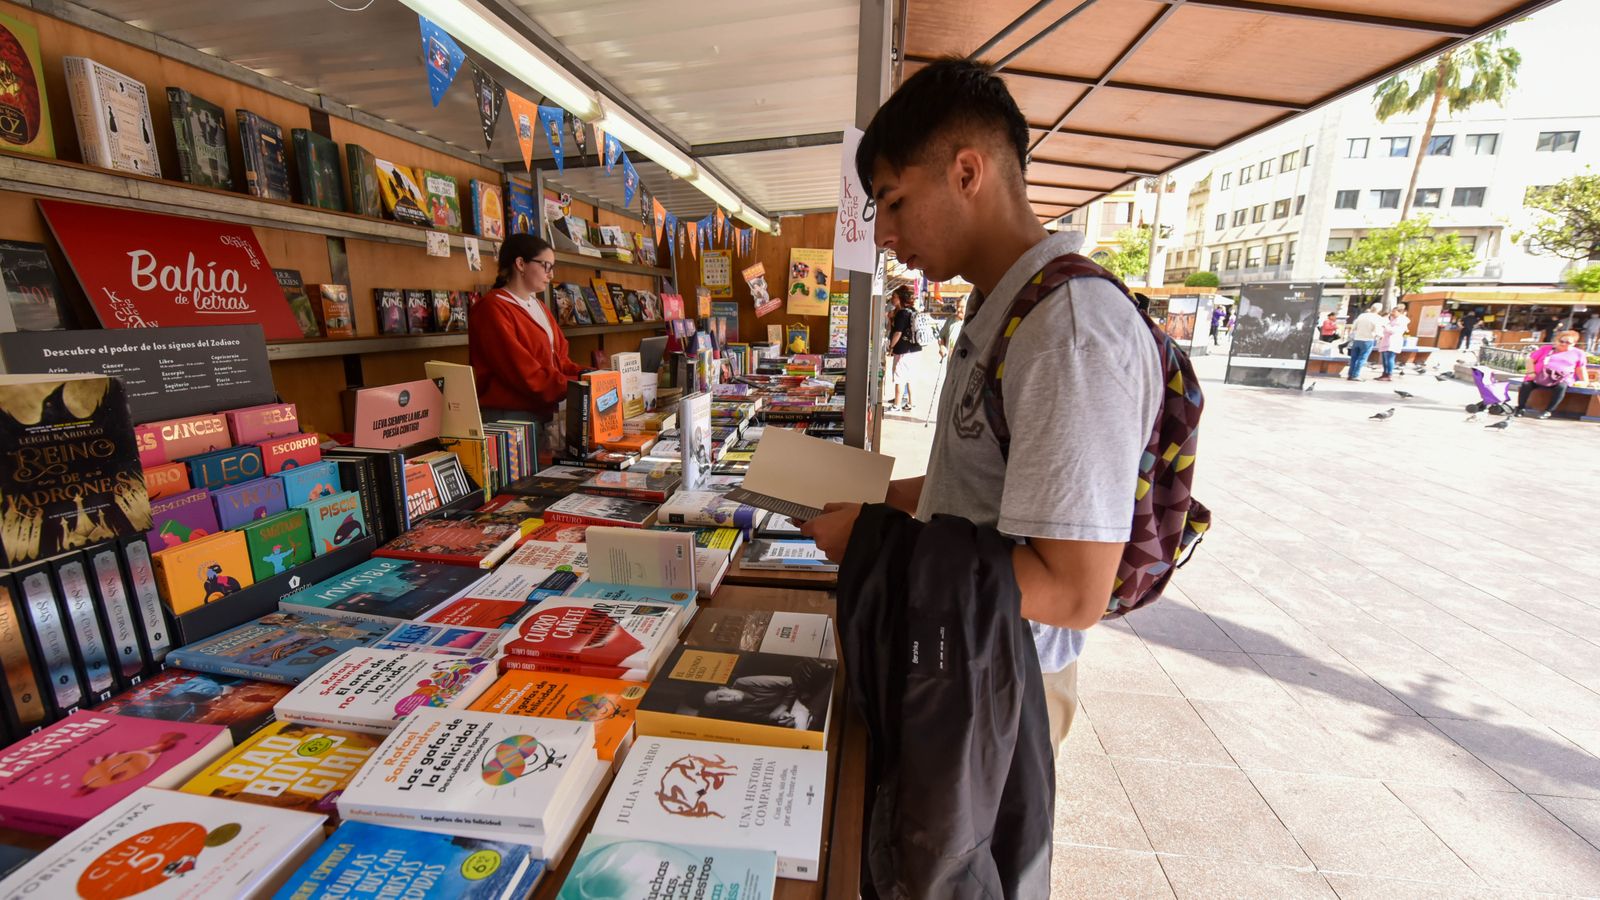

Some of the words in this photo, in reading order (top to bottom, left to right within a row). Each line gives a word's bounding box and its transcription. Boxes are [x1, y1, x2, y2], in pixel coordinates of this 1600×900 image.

[126, 249, 248, 293] Bahía
[174, 294, 190, 305] de
[193, 287, 250, 312] letras
[382, 296, 403, 308] KING
[408, 296, 427, 308] KING
[43, 346, 96, 358] Descubre
[98, 346, 109, 356] el
[110, 344, 138, 357] poder
[140, 343, 151, 352] de
[153, 342, 167, 351] los
[168, 340, 195, 352] signos
[197, 340, 209, 349] del
[210, 338, 240, 347] Zodiaco
[102, 362, 124, 370] Cáncer
[162, 370, 185, 378] Escorpio
[164, 382, 190, 391] Sagitario
[18, 434, 50, 446] LEIGH
[53, 427, 104, 441] BARDUGO
[372, 416, 388, 431] LLEVA
[387, 413, 408, 428] SIEMPRE
[408, 412, 414, 422] LA
[413, 409, 429, 421] MEJOR
[382, 426, 400, 439] POESÍA
[399, 422, 420, 436] CONTIGO
[7, 438, 116, 479] REINO
[272, 436, 318, 456] ESCORPIO
[61, 471, 81, 485] DE
[202, 452, 260, 487] LEO
[150, 492, 207, 516] ÉMINIS
[551, 514, 582, 524] ARTURO
[524, 614, 559, 643] CURRO
[552, 609, 588, 639] CAÑETE
[320, 657, 373, 696] Santandreu
[321, 662, 353, 685] Rafael
[335, 687, 350, 696] El
[349, 669, 373, 686] arte
[371, 659, 386, 669] de
[338, 696, 355, 709] no
[354, 653, 409, 695] amargarse
[368, 684, 385, 693] la
[385, 665, 407, 682] vida
[535, 681, 548, 691] de
[0, 722, 82, 769] egan
[217, 736, 301, 781] BAD
[383, 731, 419, 767] Rafael
[384, 721, 441, 784] Santandreu
[398, 768, 423, 792] Las
[420, 735, 452, 773] gafas
[446, 718, 463, 734] de
[421, 770, 442, 788] la
[438, 722, 479, 771] felicidad
[438, 757, 467, 793] Descubre
[461, 748, 471, 759] tu
[469, 721, 494, 751] fortaleza
[462, 738, 490, 772] emocional
[616, 788, 639, 824] JULIA
[632, 743, 661, 788] NAVARRO
[745, 757, 764, 802] HISTORIA
[754, 760, 777, 827] COMPARTIDA
[81, 801, 156, 854] SHARMA
[433, 816, 453, 825] gafas
[472, 818, 502, 827] felicidad
[739, 805, 753, 829] UNA
[773, 806, 782, 820] Con
[88, 834, 155, 881] CLUB
[127, 852, 166, 875] 5
[310, 843, 355, 881] ESPINOSA
[355, 849, 407, 892] BUSCAN
[319, 853, 378, 900] RÚJULAS
[377, 860, 424, 900] RISAS
[400, 864, 446, 900] RDIDAS
[648, 861, 669, 900] uchas
[661, 875, 681, 900] das,
[679, 864, 697, 900] uchos
